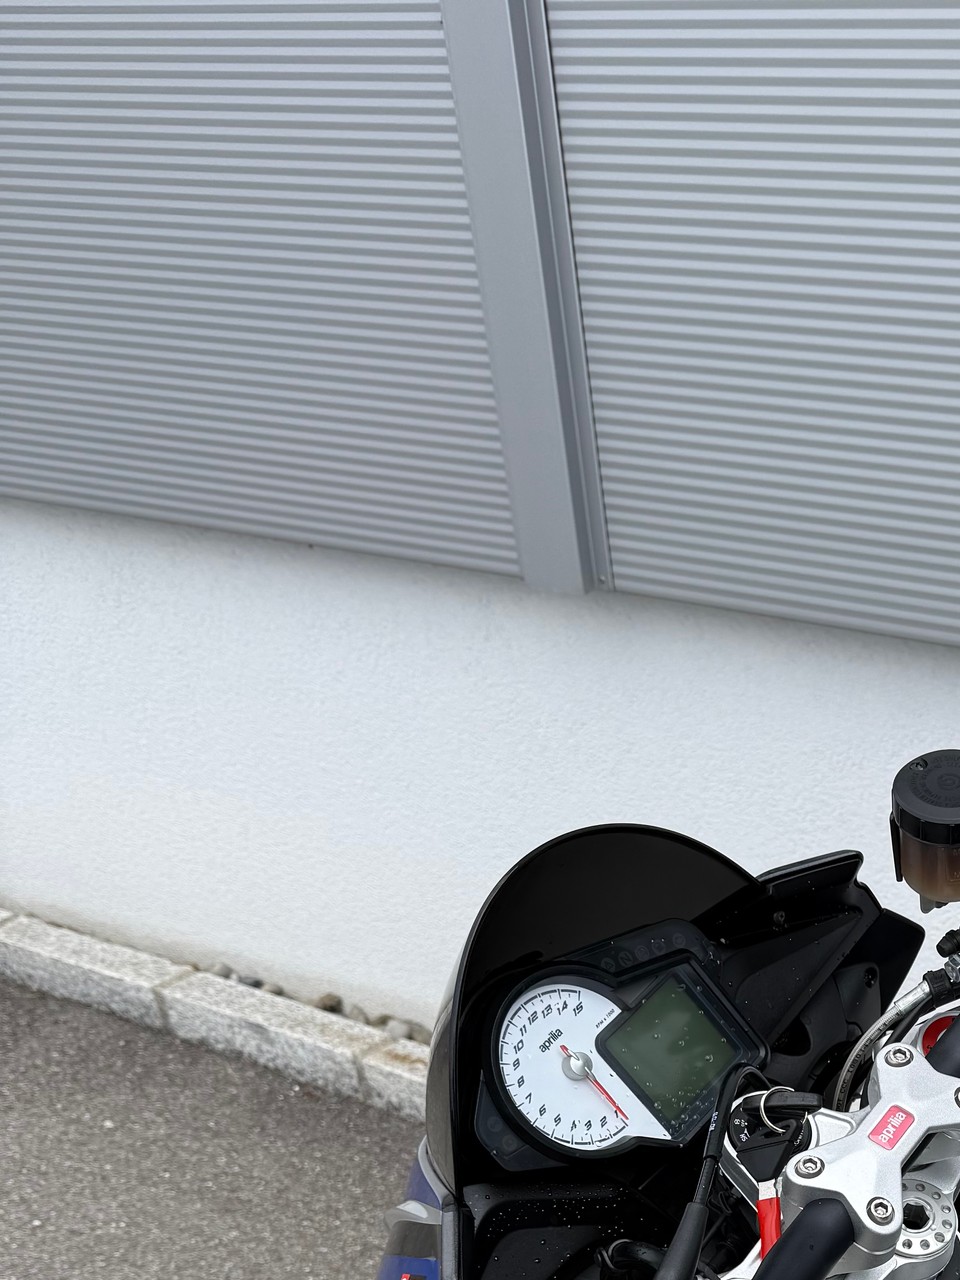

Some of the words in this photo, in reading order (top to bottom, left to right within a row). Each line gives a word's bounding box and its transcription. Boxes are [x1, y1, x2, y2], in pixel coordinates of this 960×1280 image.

[541, 1004, 553, 1019] 13
[556, 1000, 568, 1015] 14
[572, 1001, 584, 1017] 15
[527, 1010, 539, 1025] 12
[519, 1024, 527, 1037] 11
[513, 1039, 524, 1055] 10
[538, 1028, 564, 1053] aprilia
[512, 1058, 520, 1071] 9
[517, 1075, 525, 1088] 8
[525, 1092, 532, 1104] 7
[538, 1104, 547, 1117] 6
[553, 1113, 562, 1127] 5
[570, 1120, 578, 1132] 4
[584, 1119, 593, 1131] 3
[599, 1115, 608, 1128] 2
[878, 1112, 906, 1143] aprilia
